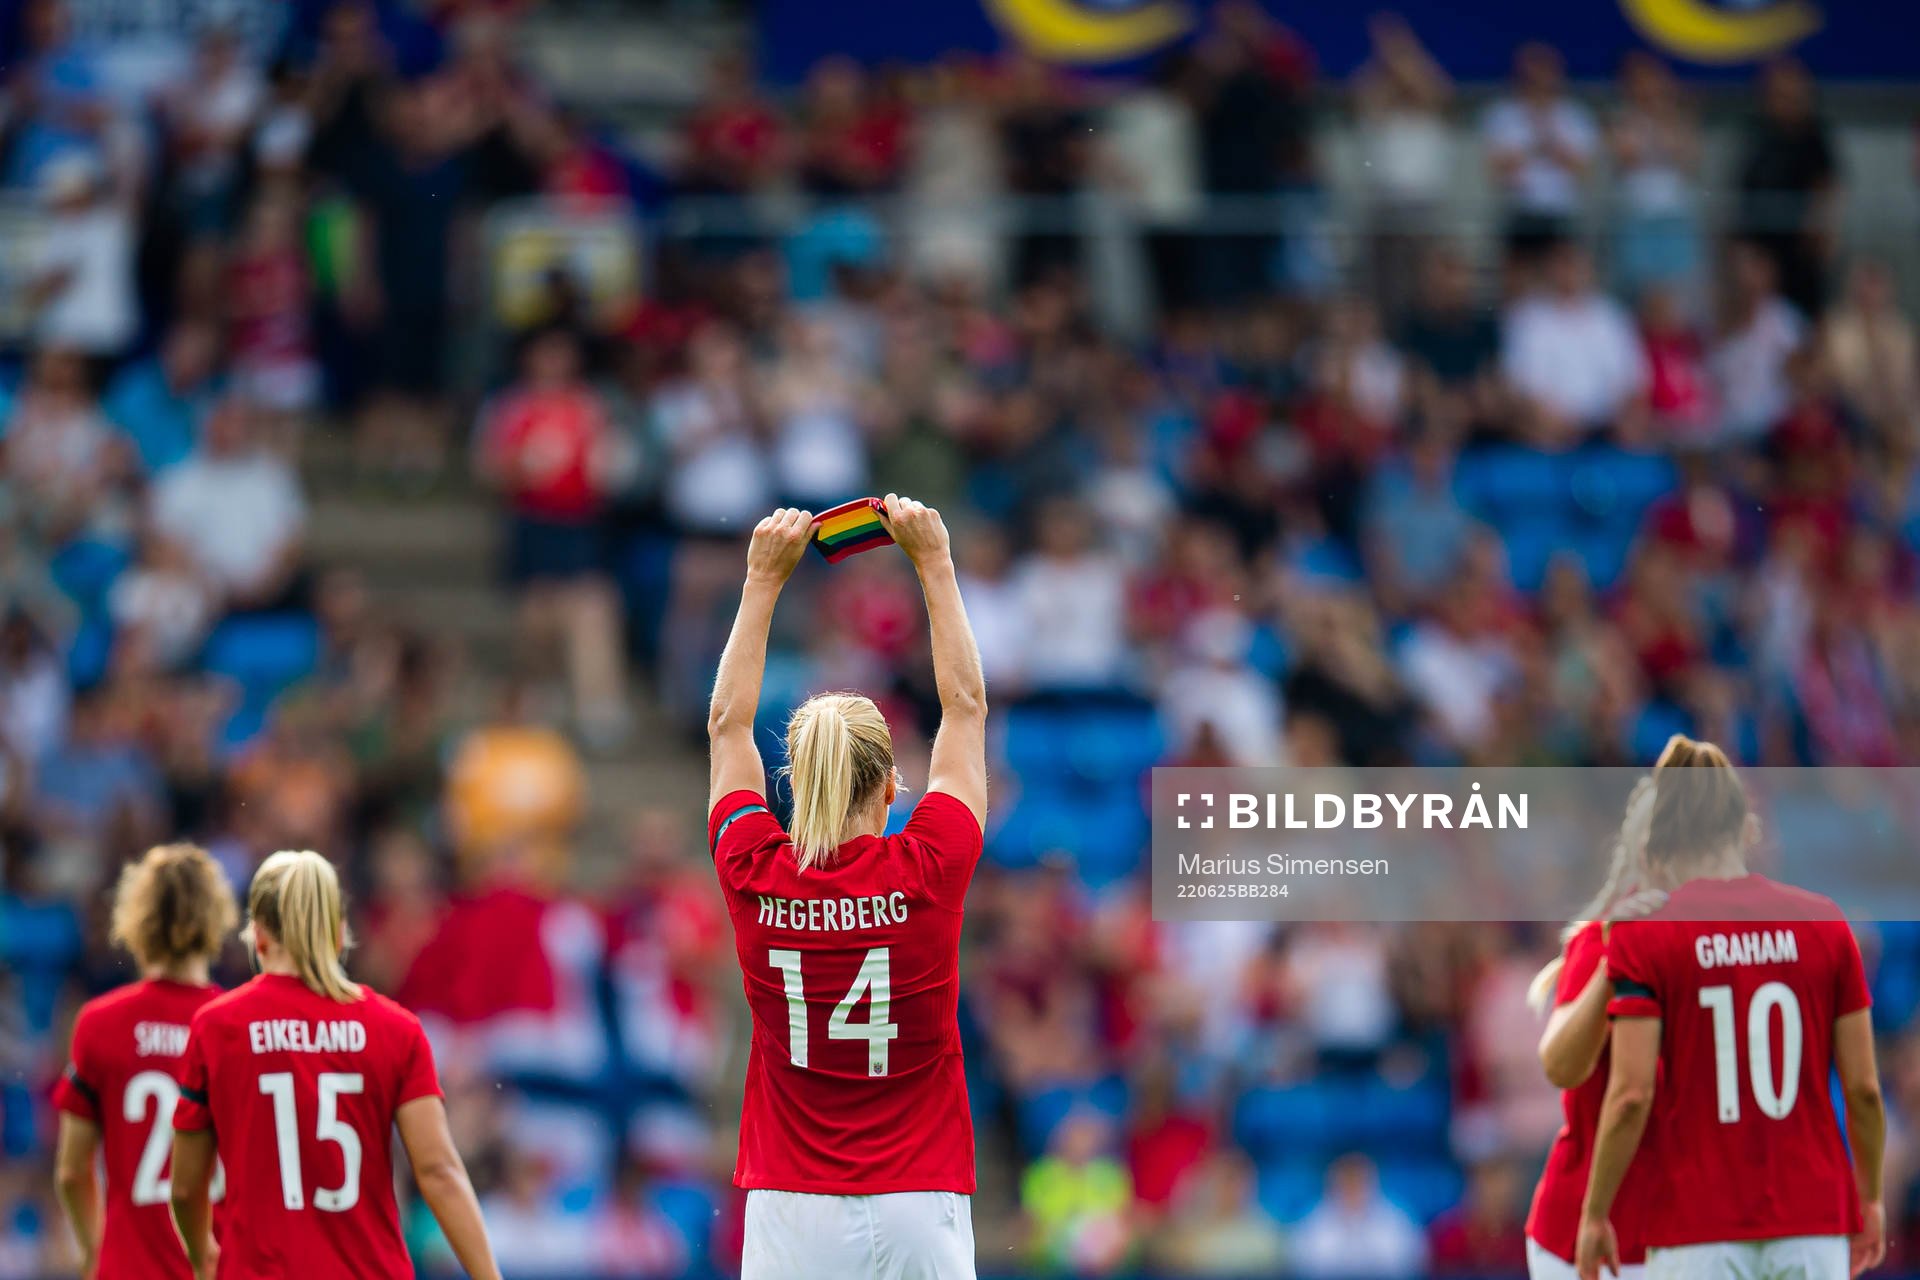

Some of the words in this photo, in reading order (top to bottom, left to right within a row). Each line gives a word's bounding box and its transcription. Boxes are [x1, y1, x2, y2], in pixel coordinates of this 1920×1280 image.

[757, 891, 909, 932] HEGERBERG
[1695, 929, 1799, 970] GRAHAM
[248, 1019, 367, 1054] EIKELAND
[768, 947, 899, 1078] 14
[1698, 981, 1803, 1124] 10
[123, 1070, 227, 1206] 2
[258, 1072, 365, 1212] 15
